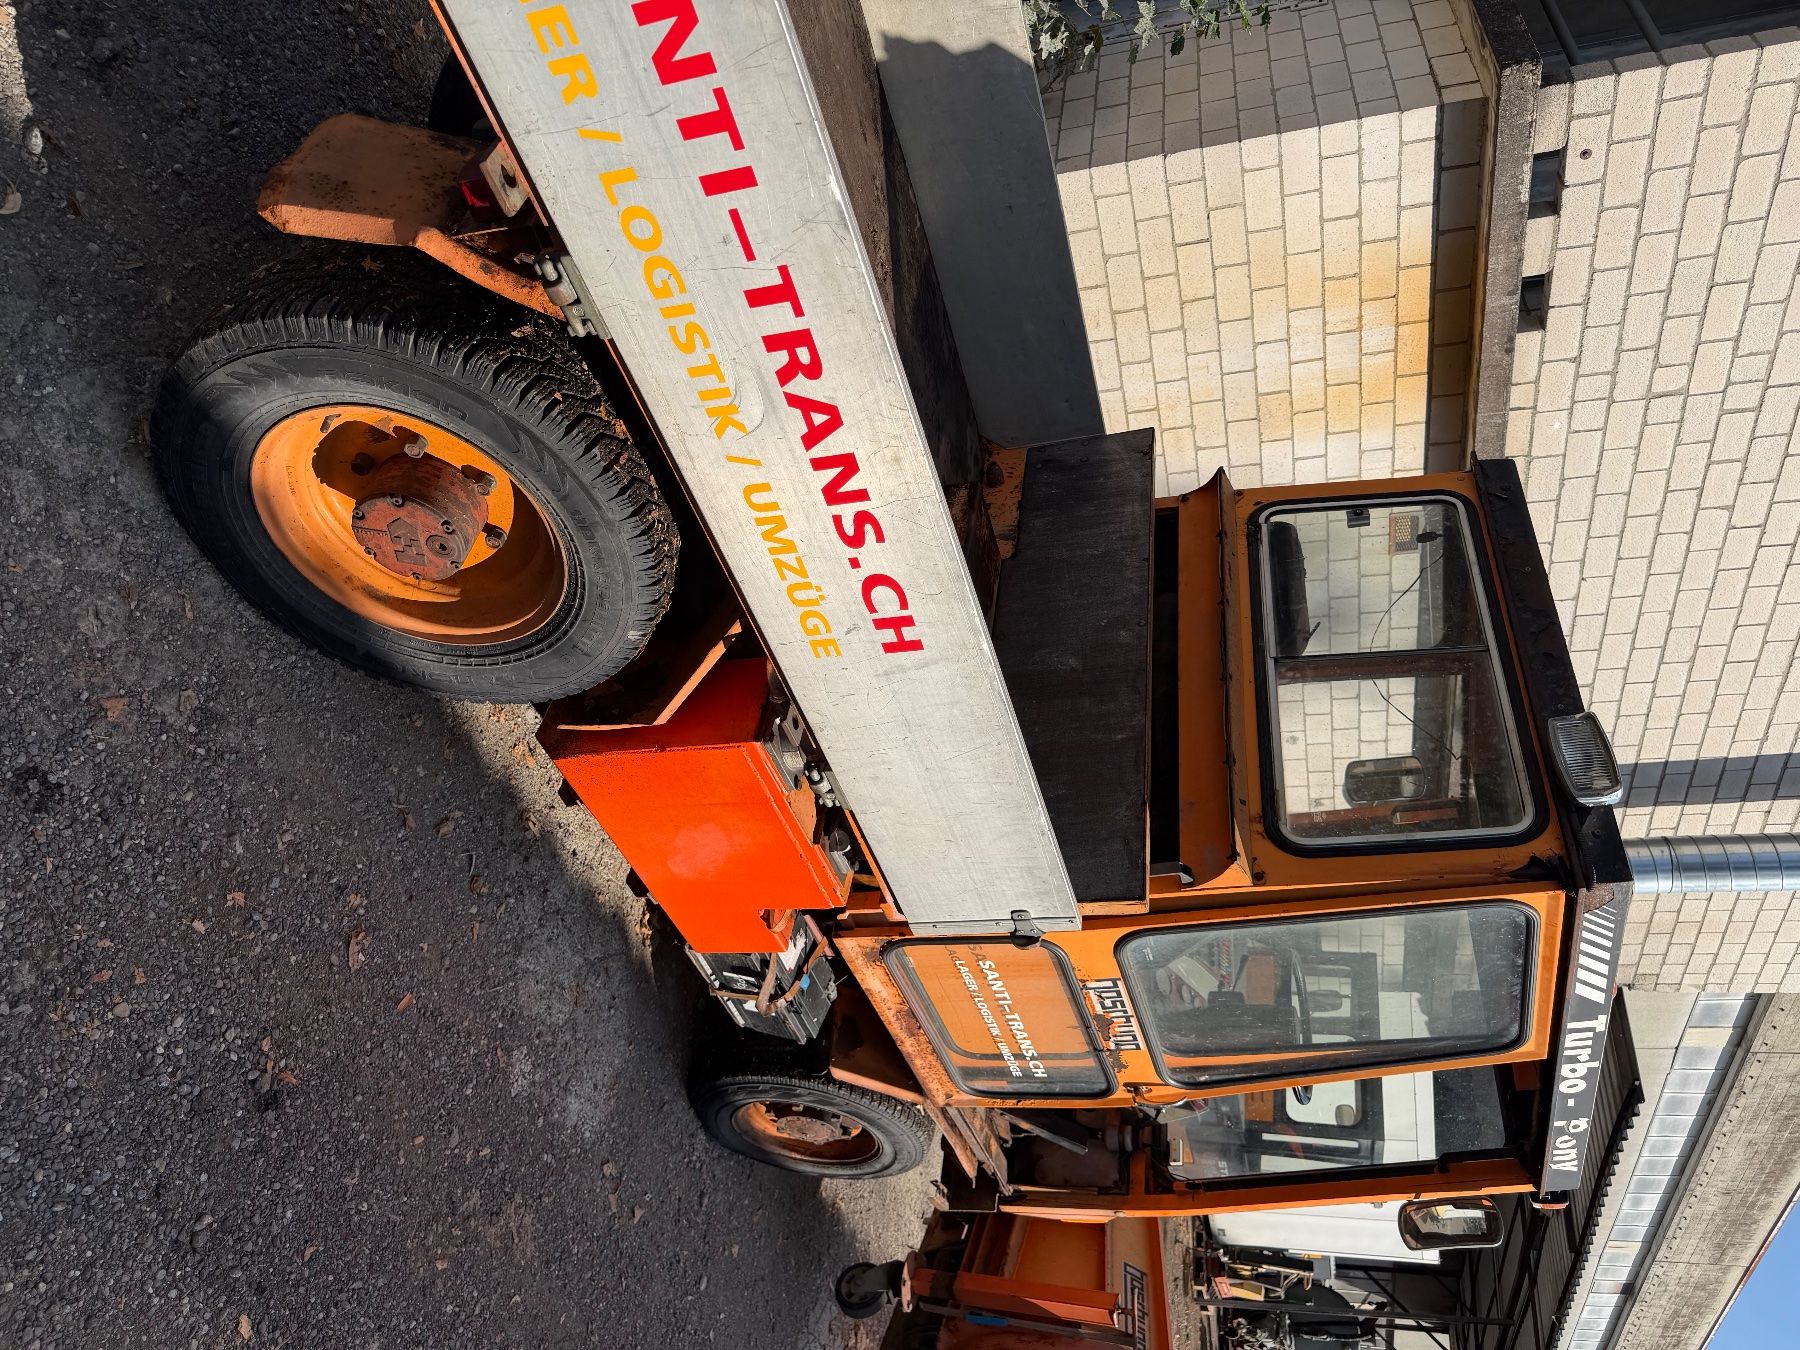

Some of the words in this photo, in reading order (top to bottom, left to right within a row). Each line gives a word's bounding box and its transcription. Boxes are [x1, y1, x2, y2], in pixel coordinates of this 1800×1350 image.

[519, 0, 598, 105] ER
[578, 128, 624, 145] /
[599, 167, 748, 440] LOGISTIK
[726, 455, 762, 468] /
[743, 483, 841, 659] UMZÜGE
[954, 960, 978, 992] LAGER
[975, 997, 1002, 1037] LOGISTIK
[979, 960, 1047, 1078] SANTI-TRANS.CH
[1548, 1117, 1589, 1172] Pony
